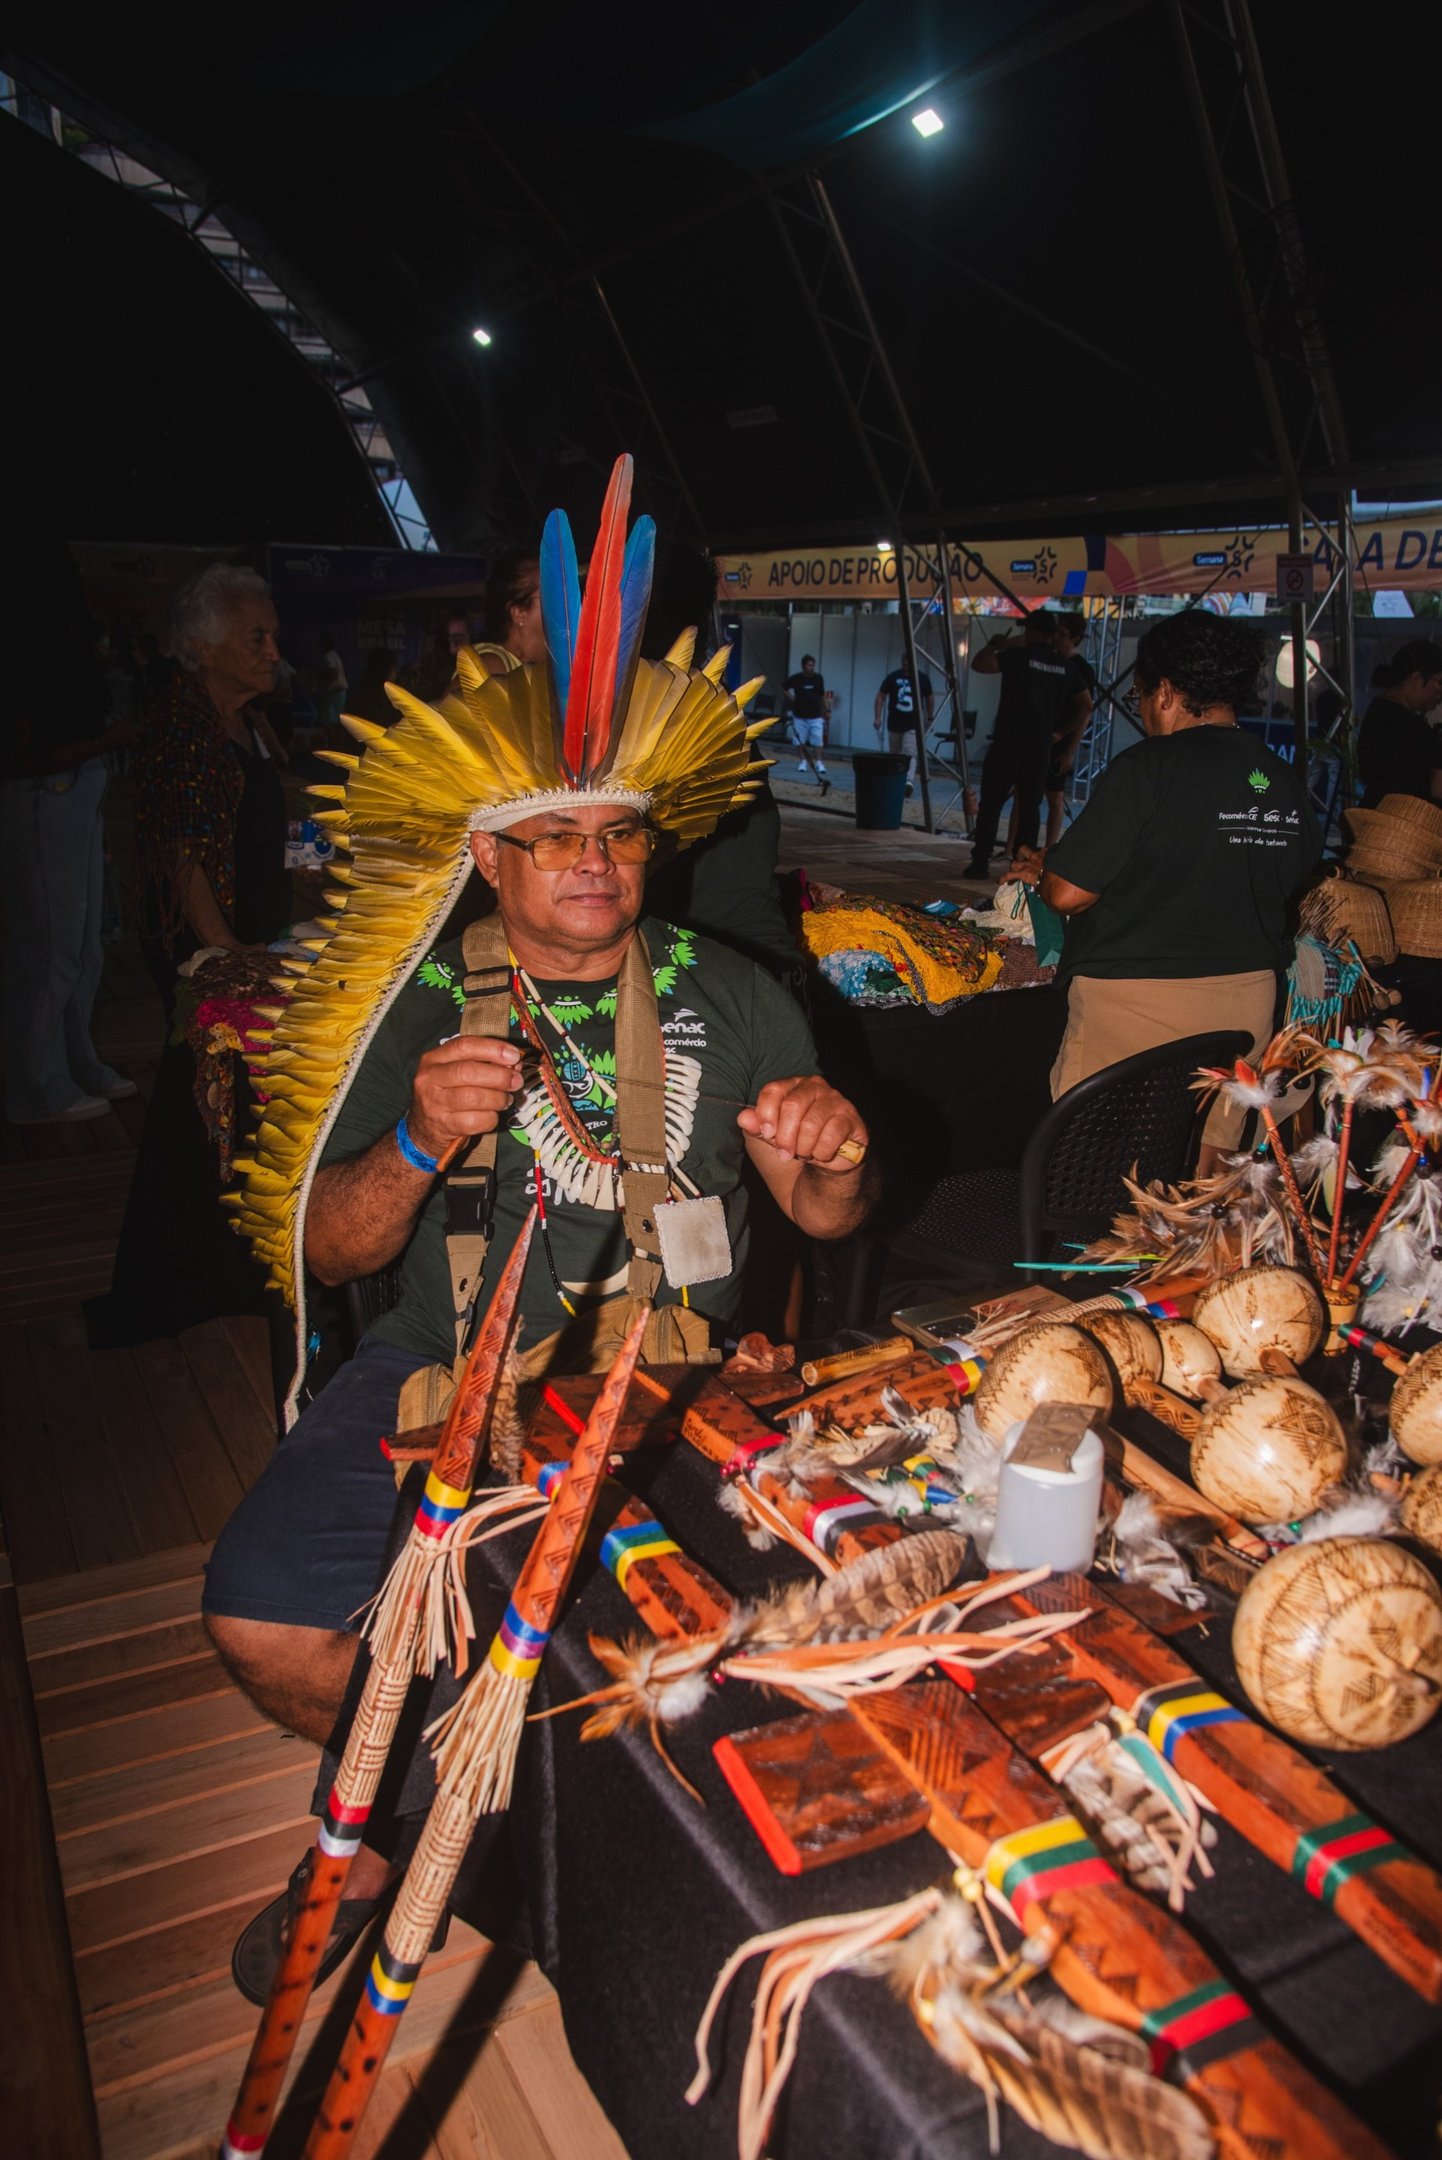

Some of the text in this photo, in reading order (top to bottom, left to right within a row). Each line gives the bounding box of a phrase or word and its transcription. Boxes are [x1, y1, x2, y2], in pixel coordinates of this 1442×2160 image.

[1303, 531, 1384, 572] AA
[768, 560, 826, 586] APOIO
[829, 558, 854, 584] DE
